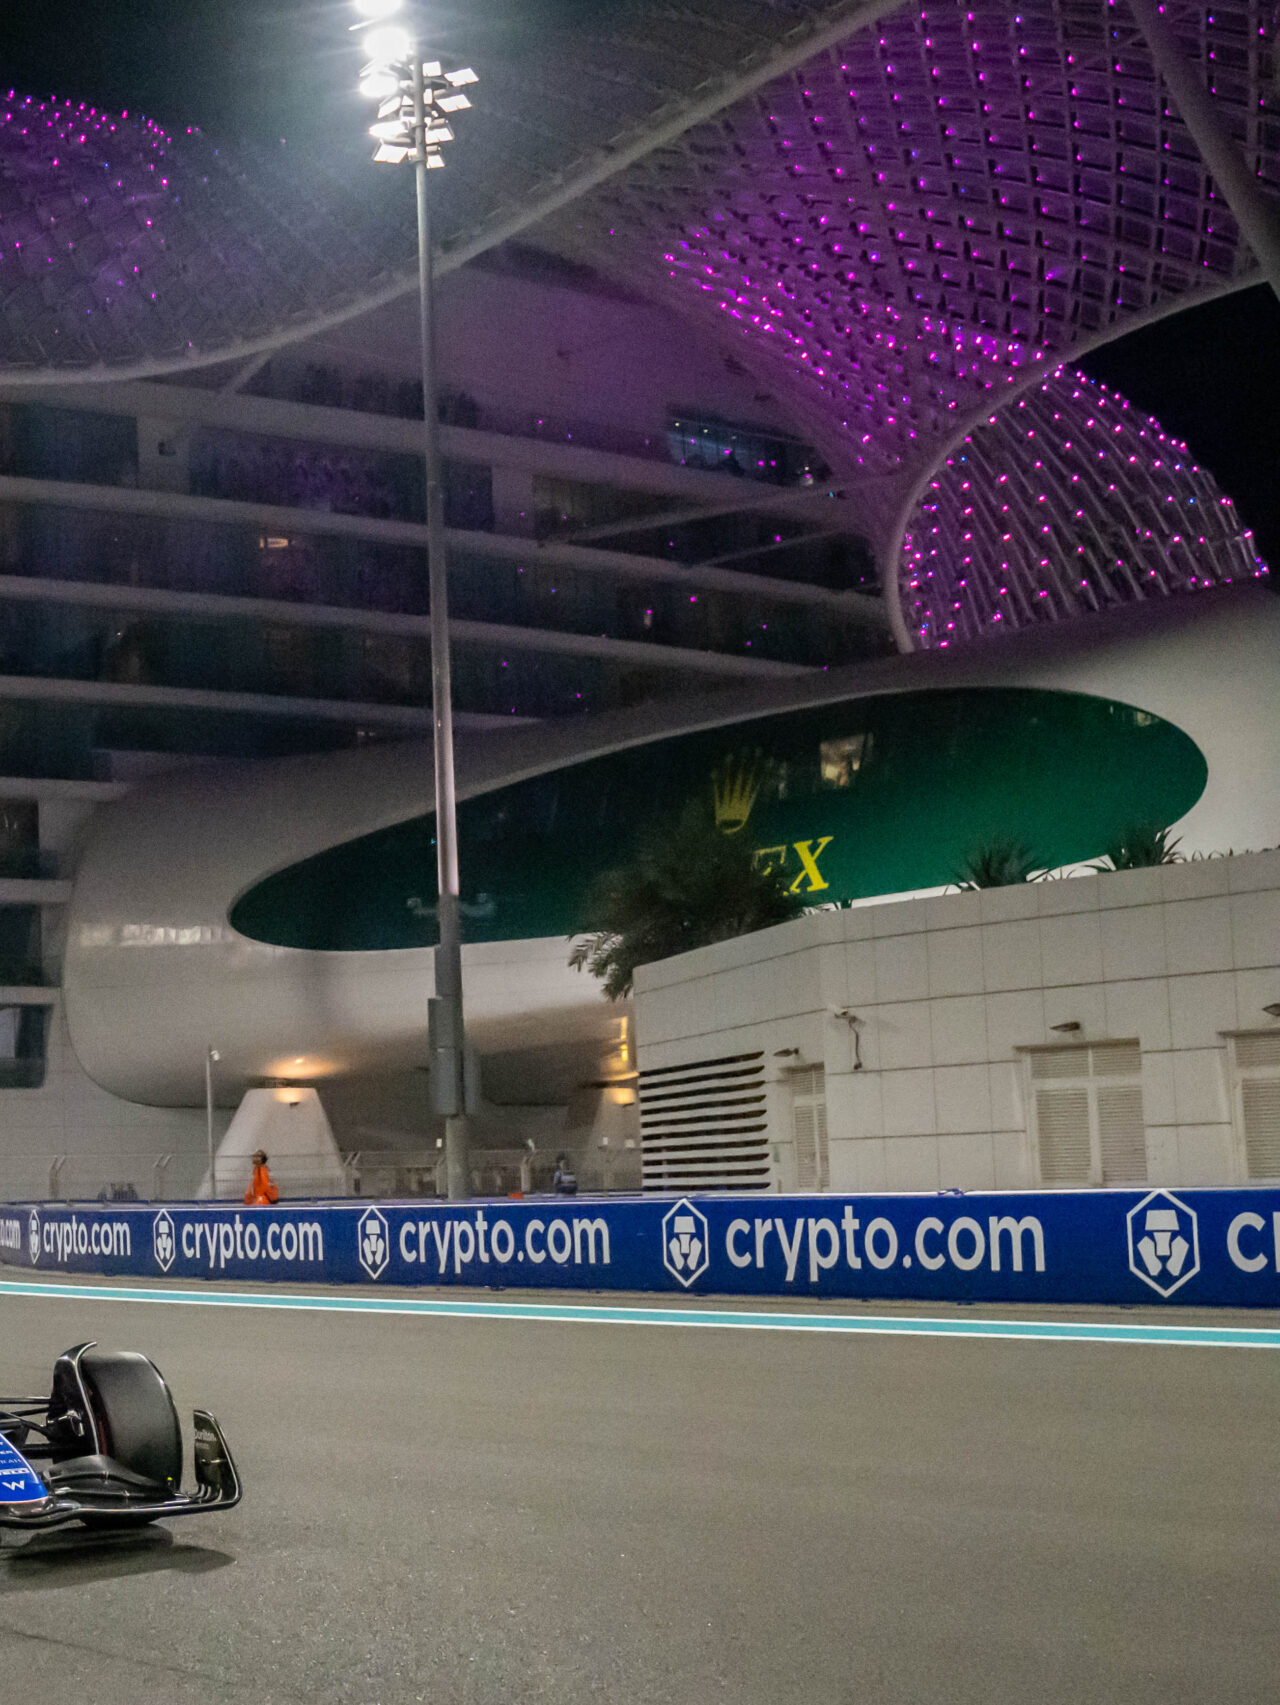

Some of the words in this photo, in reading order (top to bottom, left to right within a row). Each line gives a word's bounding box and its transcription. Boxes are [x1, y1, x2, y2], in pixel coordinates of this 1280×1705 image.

[43, 1213, 131, 1262] crypto.com
[182, 1213, 324, 1268] crypto.com
[399, 1210, 610, 1274] crypto.com
[725, 1205, 1045, 1282] crypto.com
